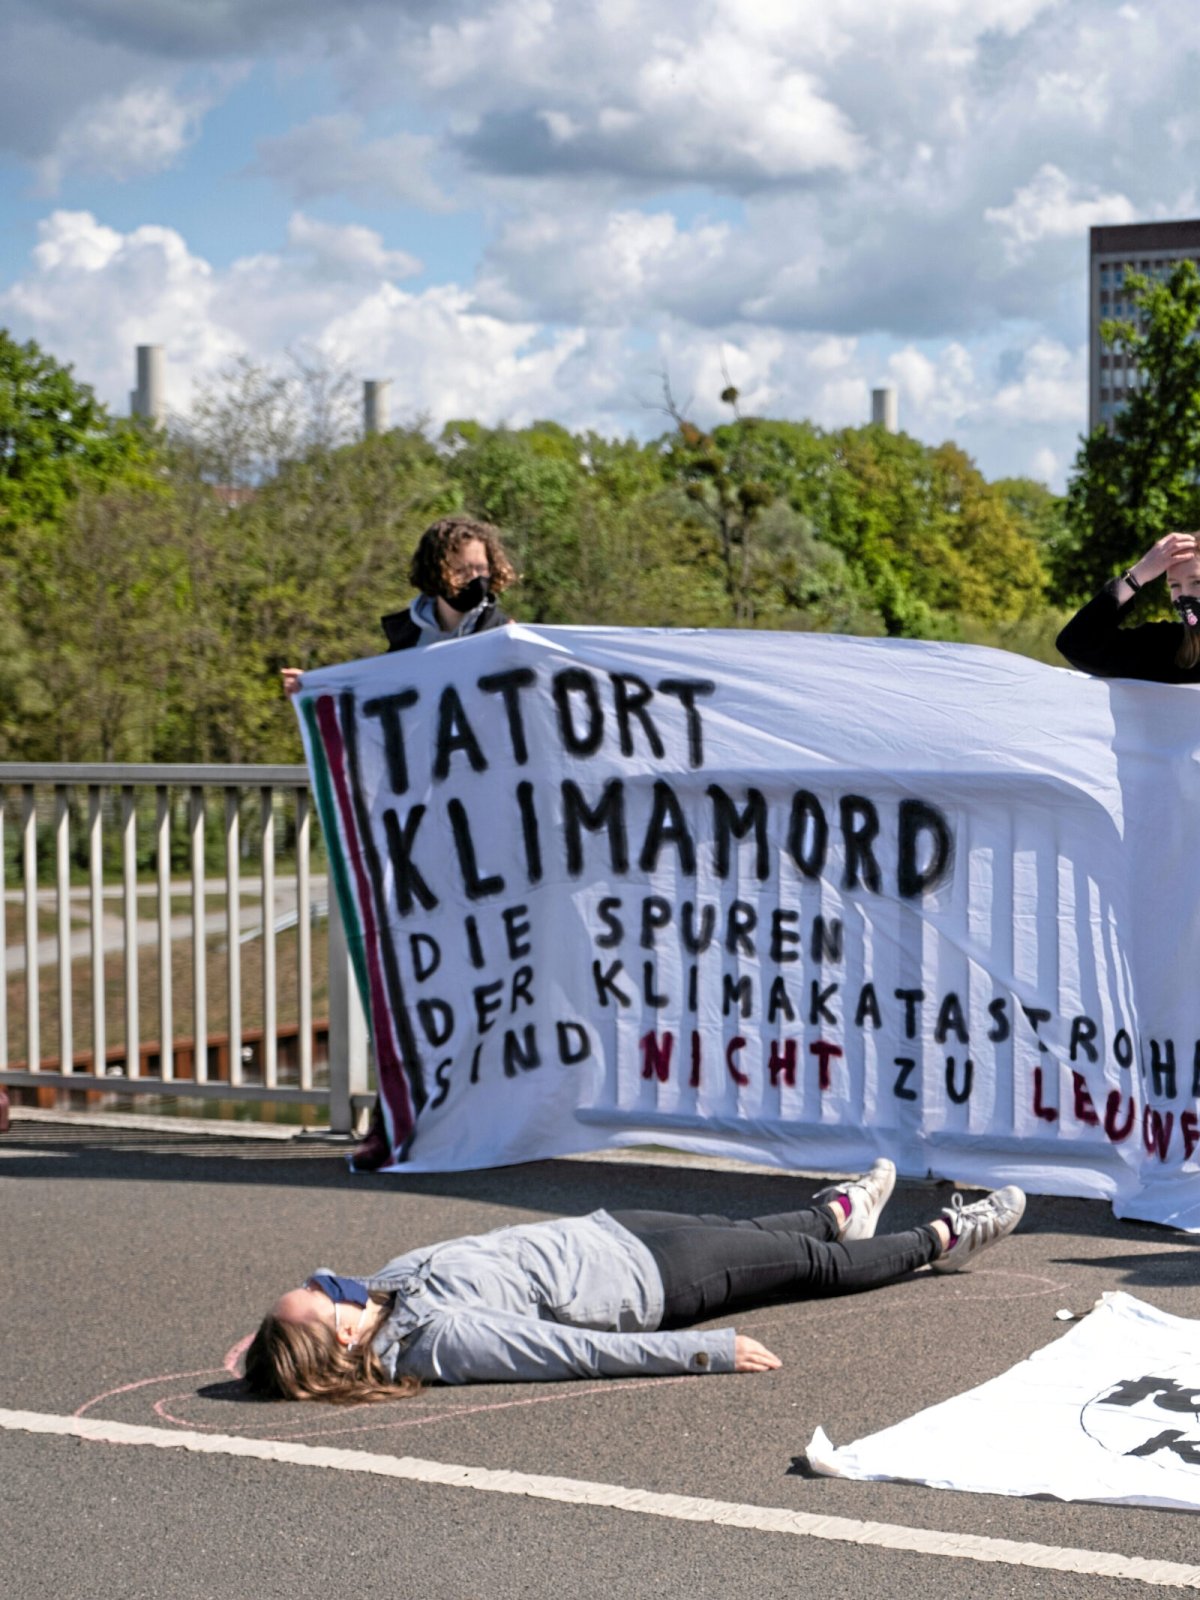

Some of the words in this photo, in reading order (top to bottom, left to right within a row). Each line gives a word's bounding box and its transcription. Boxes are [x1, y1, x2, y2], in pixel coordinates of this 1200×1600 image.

[364, 667, 715, 796] TATORT
[383, 778, 955, 914] KLIMAMORD
[410, 904, 532, 982] DIE
[595, 896, 844, 965] SPUREN
[416, 964, 534, 1048] DER
[431, 1021, 592, 1110] SIND
[640, 1030, 844, 1090] NICHT
[893, 1056, 974, 1104] ZU
